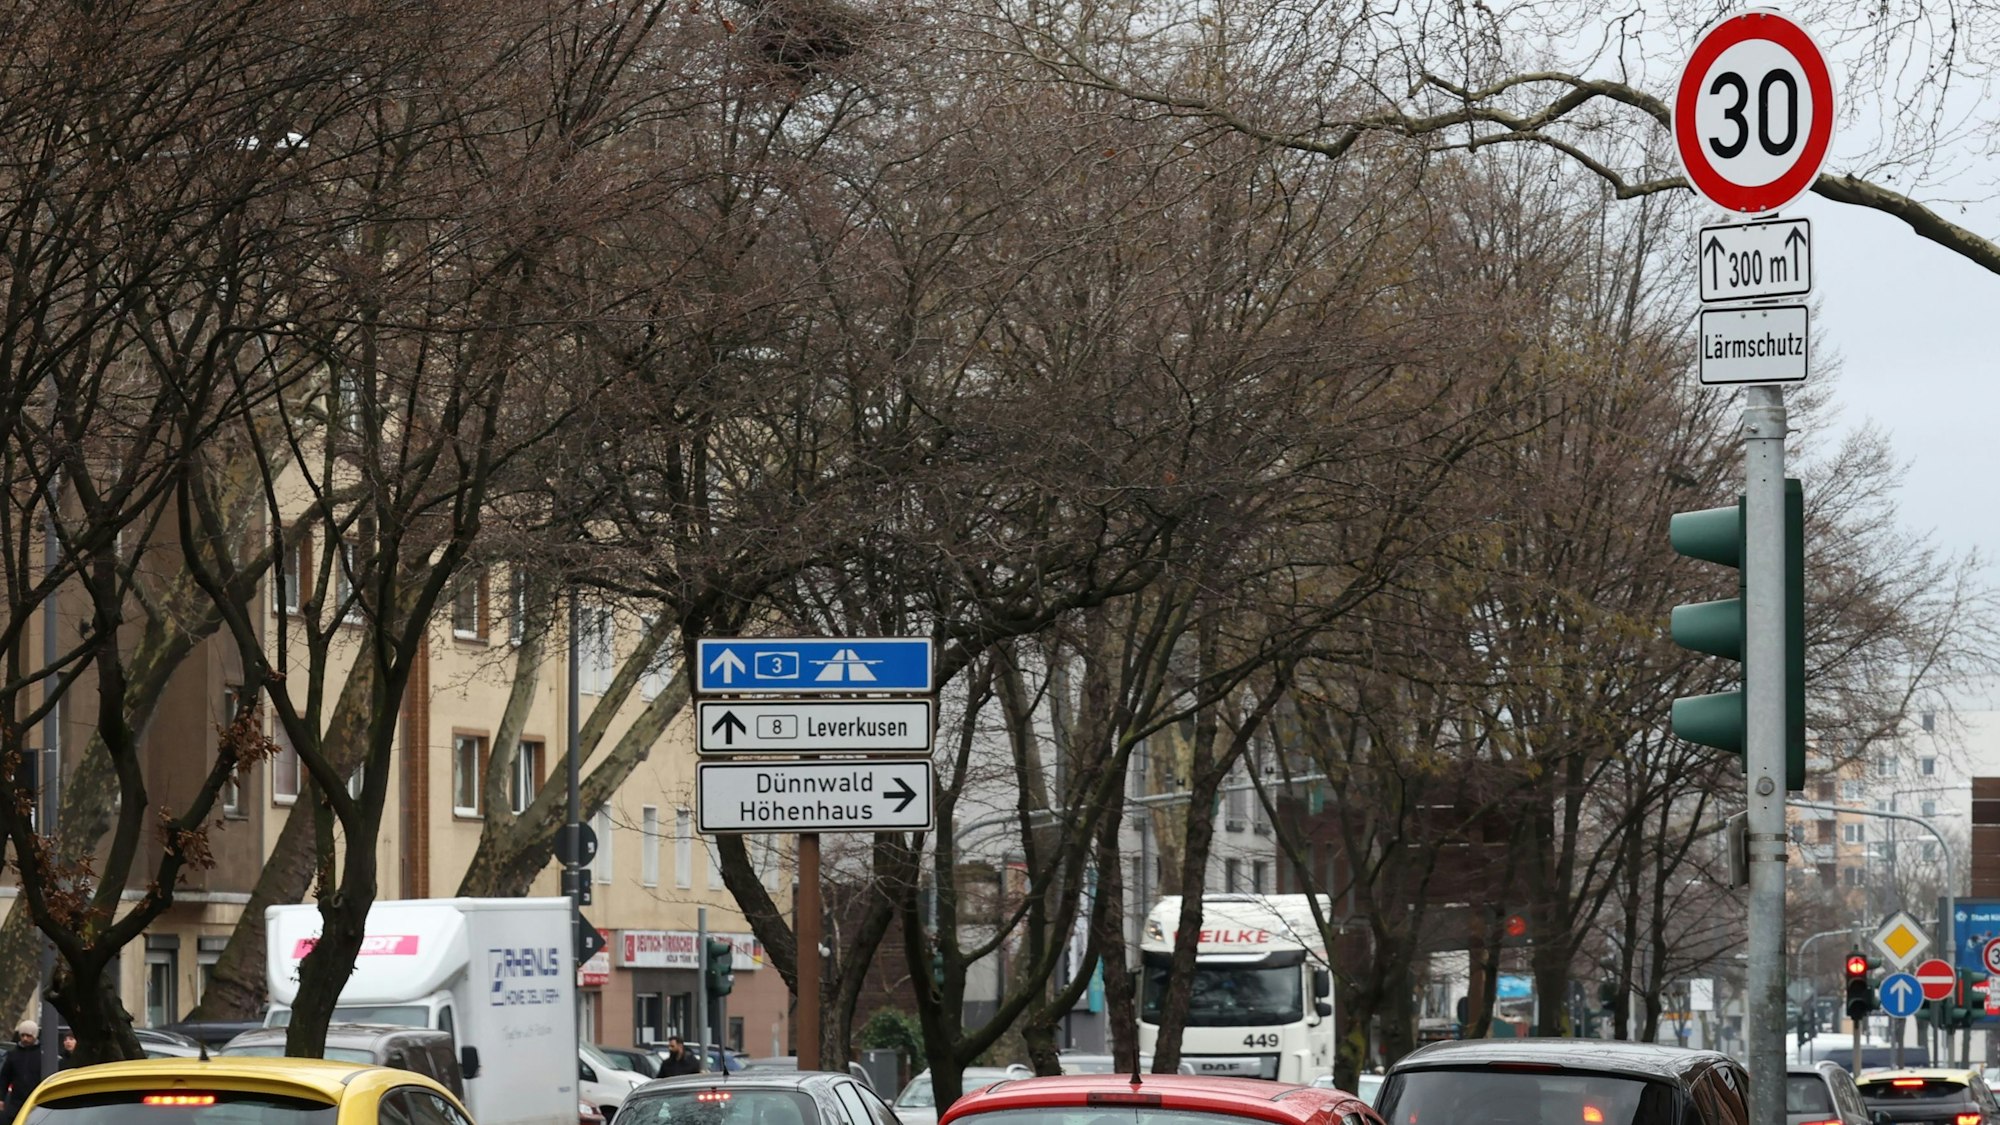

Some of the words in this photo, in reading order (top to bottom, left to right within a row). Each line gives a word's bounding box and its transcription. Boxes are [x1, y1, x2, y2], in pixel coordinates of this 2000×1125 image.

[1709, 68, 1798, 159] 30
[1729, 249, 1763, 288] 300
[1770, 255, 1788, 283] m
[1705, 331, 1803, 360] Lärmschutz
[772, 658, 782, 673] 3
[772, 720, 782, 735] 8
[808, 717, 907, 737] Leverkusen
[757, 772, 873, 793] Dünnwald
[741, 801, 873, 821] Höhenhaus
[1174, 930, 1270, 944] EILKE
[504, 948, 558, 977] RHENUS
[1243, 1034, 1279, 1049] 449
[1201, 1063, 1241, 1071] DAF
